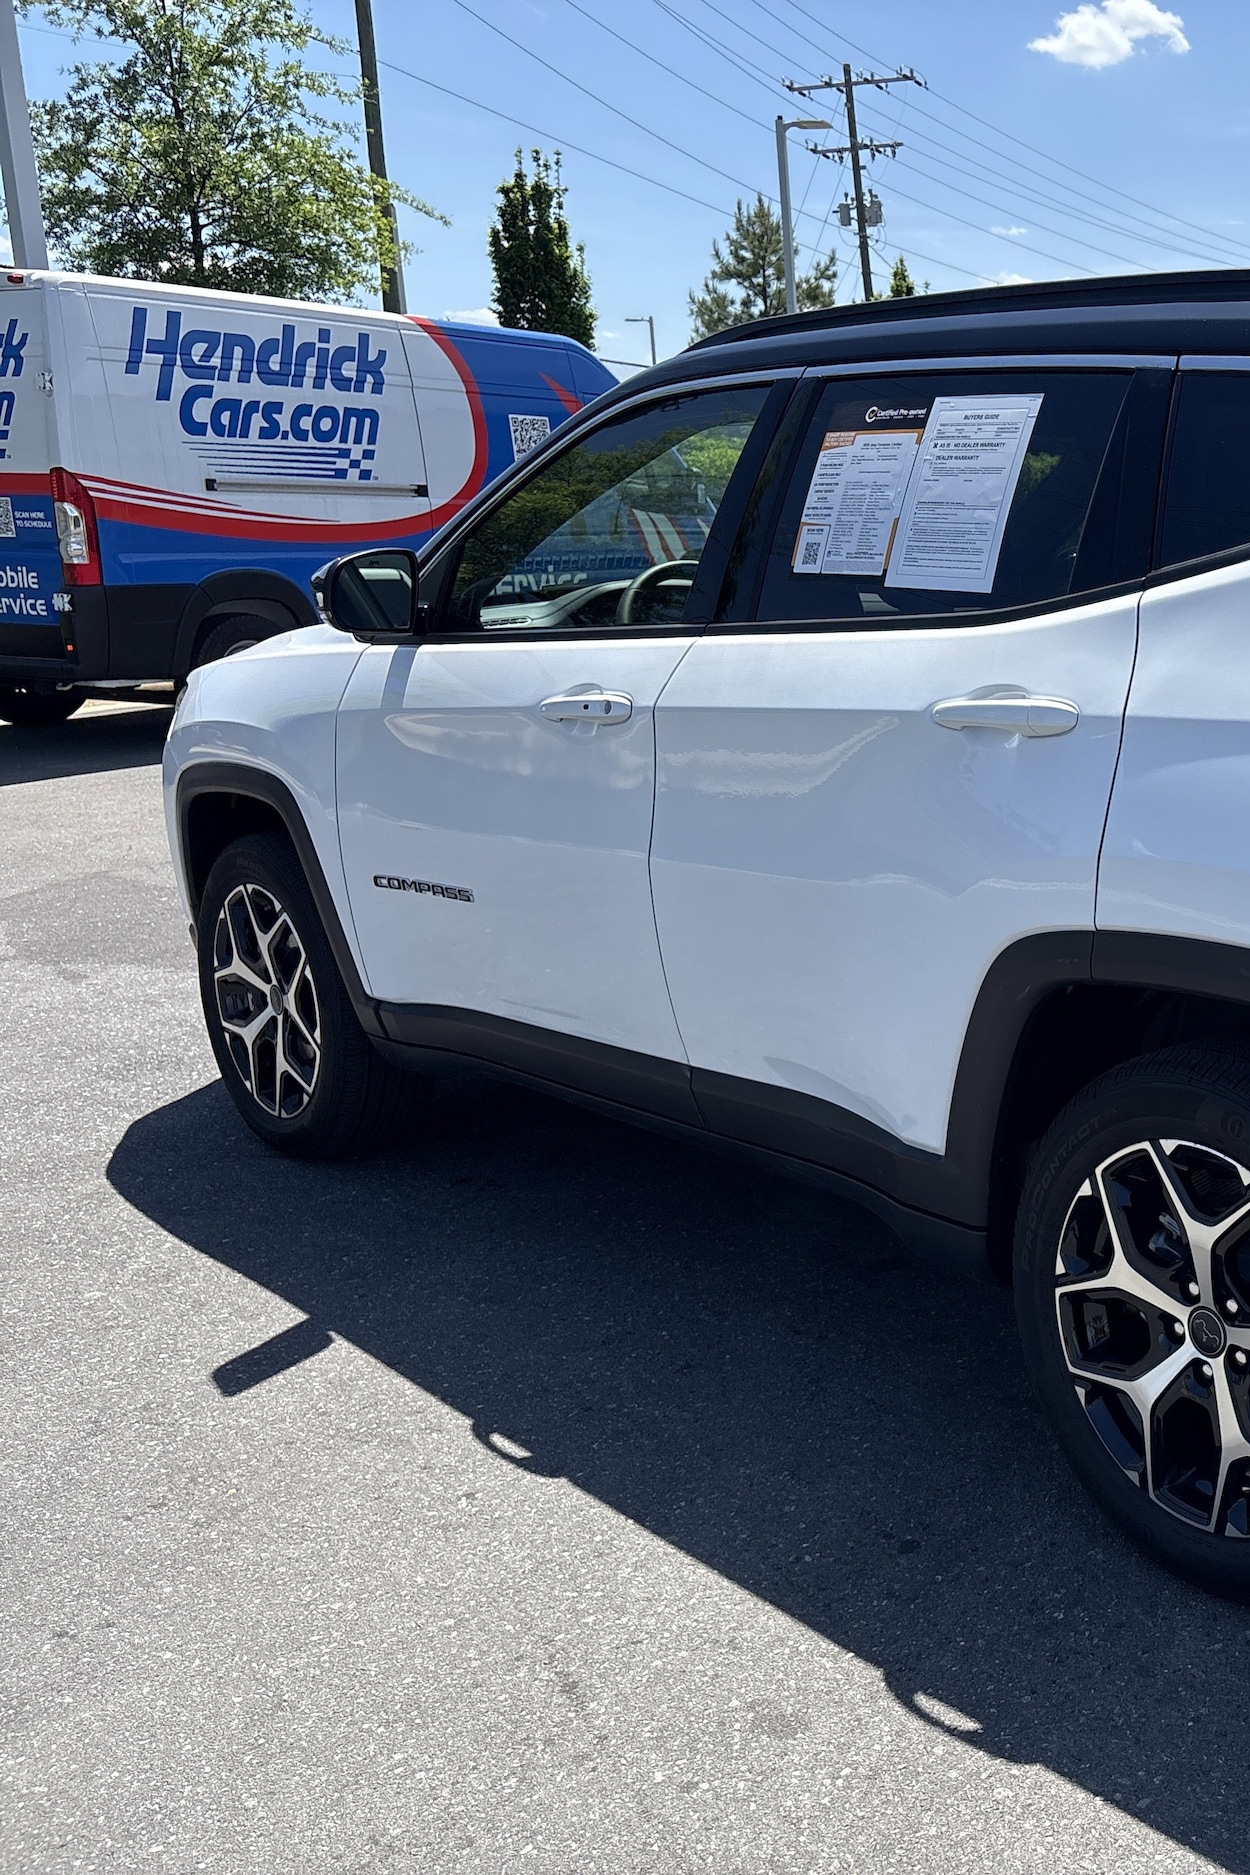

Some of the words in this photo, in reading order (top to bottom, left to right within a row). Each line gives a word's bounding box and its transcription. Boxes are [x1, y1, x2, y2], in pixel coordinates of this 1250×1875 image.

[125, 306, 387, 401] Hendrick
[179, 384, 380, 446] Cars.com
[14, 511, 30, 519] SCAN
[30, 511, 46, 520] HERE
[16, 520, 24, 528] TO
[24, 520, 53, 529] SCHEDULE
[373, 874, 475, 903] COMPASS
